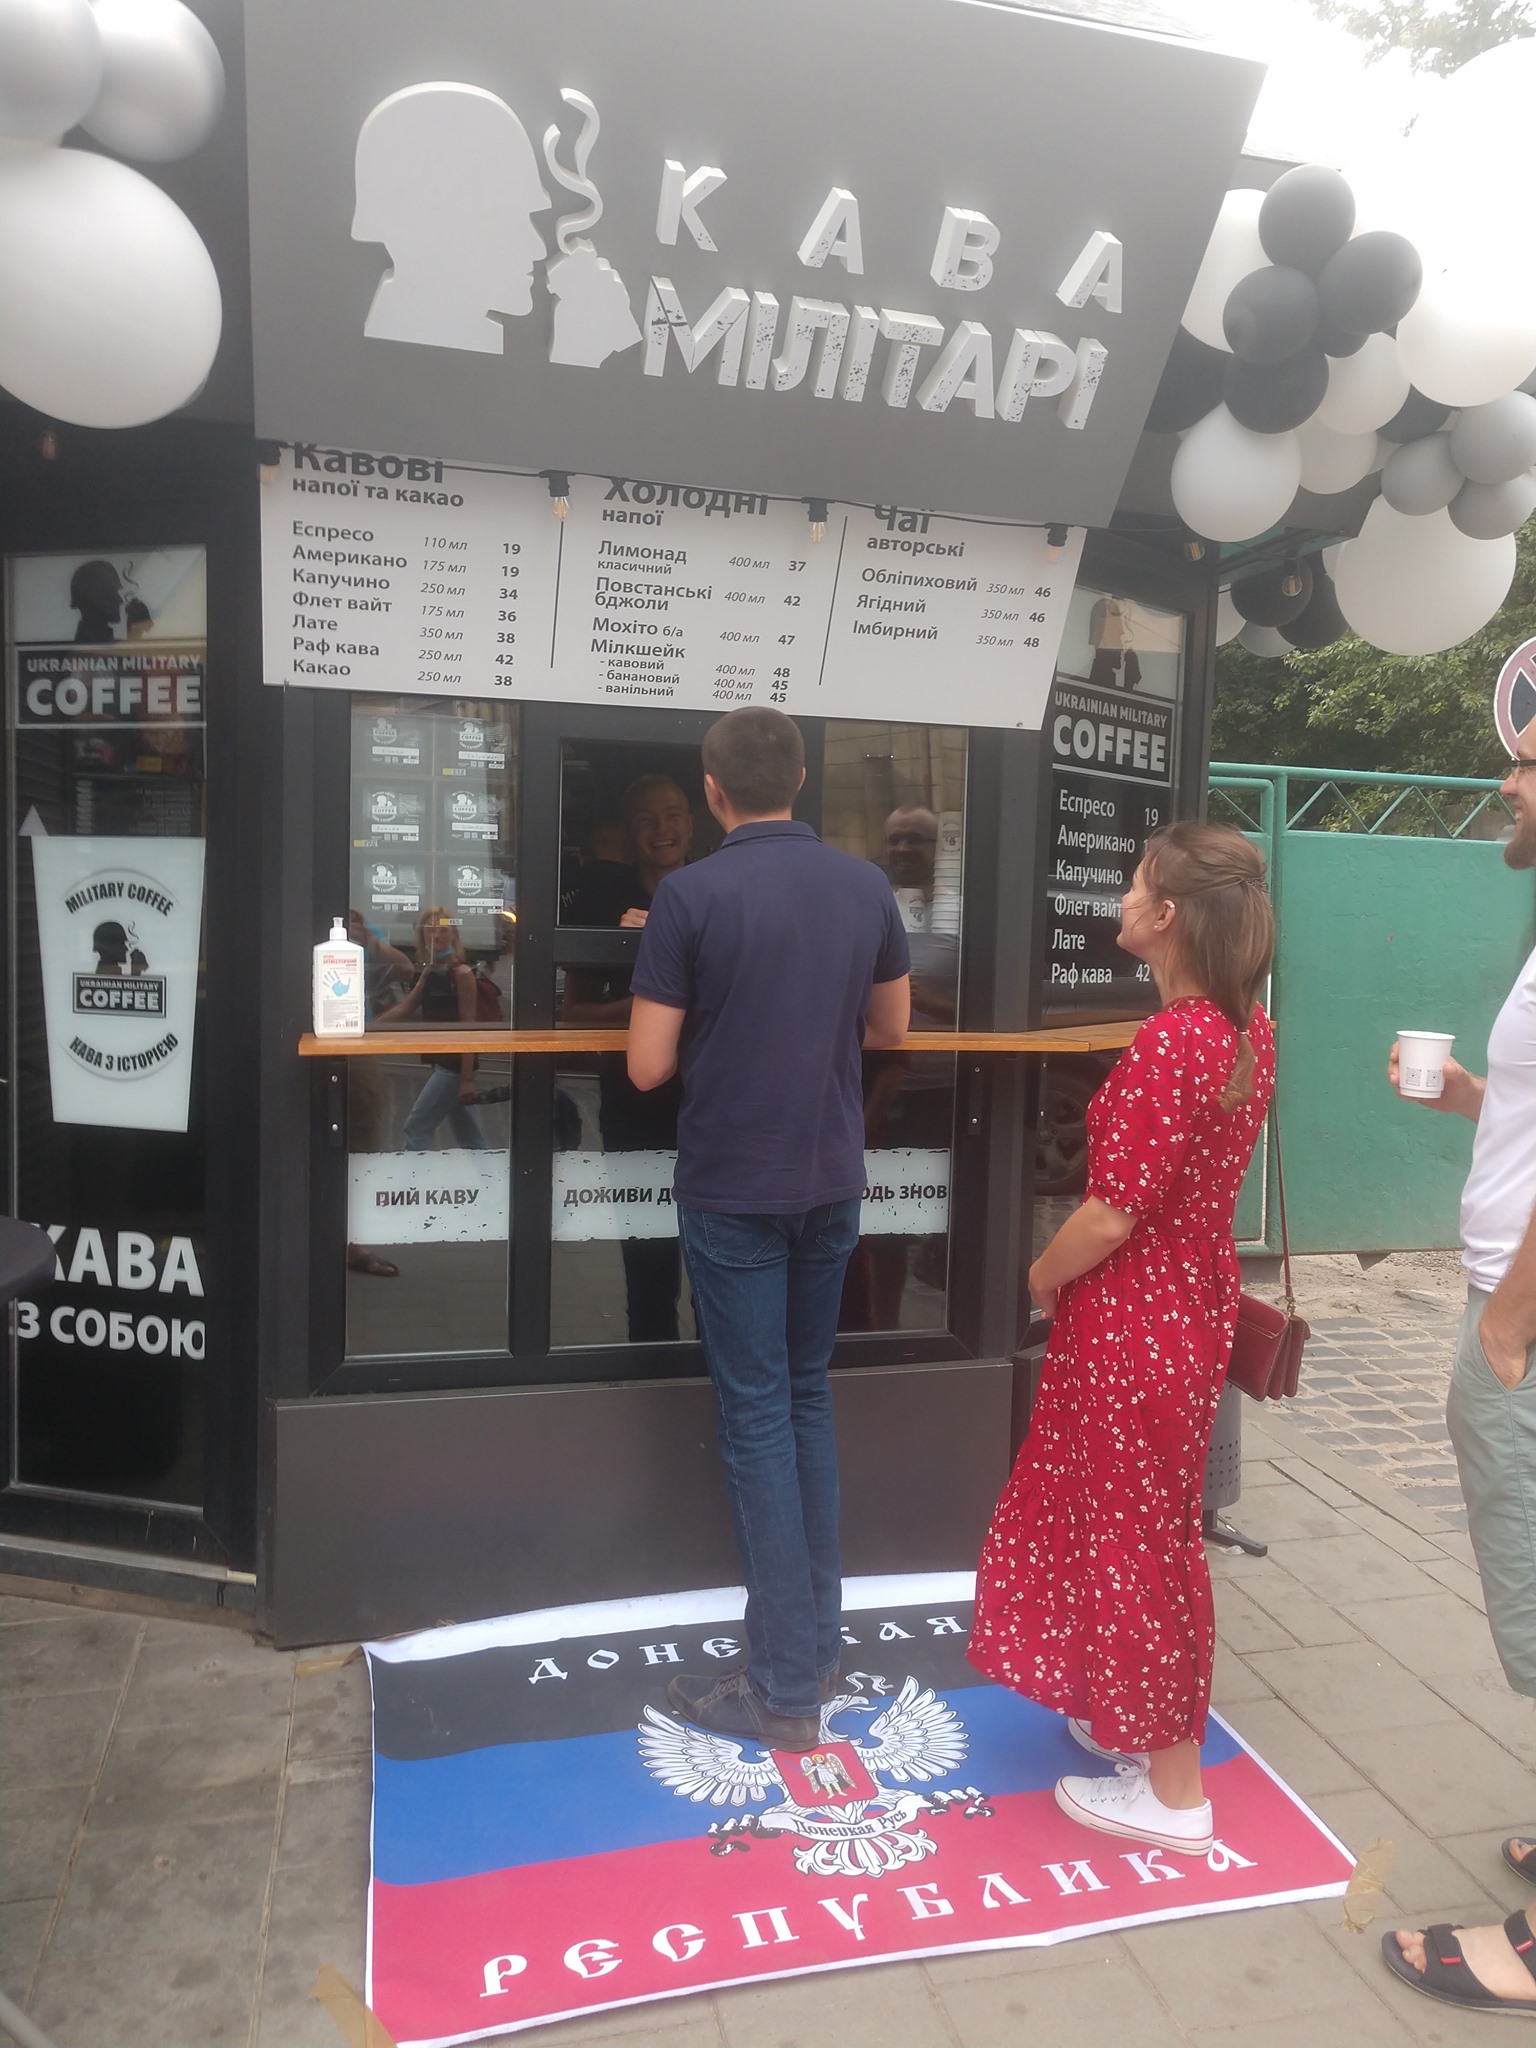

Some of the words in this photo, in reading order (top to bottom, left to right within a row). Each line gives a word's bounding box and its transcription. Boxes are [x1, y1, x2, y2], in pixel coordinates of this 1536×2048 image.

[656, 159, 1123, 313] КАВА
[643, 275, 1109, 430] МІЛІТАРІ
[294, 443, 443, 483] Кавові
[292, 478, 360, 497] напої
[364, 485, 389, 500] та
[396, 489, 464, 507] какао
[604, 478, 769, 518] Холодні
[602, 505, 663, 527] напої
[874, 504, 933, 533] Чаї
[292, 521, 374, 543] Еспресо
[423, 536, 446, 550] 110
[449, 542, 468, 551] мл
[503, 542, 521, 555] 19
[867, 537, 965, 558] авторські
[292, 545, 407, 568] Американо
[422, 560, 445, 572] 175
[447, 564, 467, 574] мл
[501, 565, 520, 578] 19
[598, 540, 687, 565] Лимонад
[729, 556, 752, 569] 400
[753, 559, 770, 570] мл
[789, 560, 806, 573] 37
[598, 560, 672, 576] класичний
[292, 569, 390, 591] Капучино
[420, 582, 444, 595] 250
[446, 586, 465, 596] мл
[499, 588, 518, 600] 34
[596, 576, 712, 600] Повстанські
[724, 591, 748, 604] 400
[749, 595, 765, 605] мл
[784, 595, 801, 607] 42
[862, 567, 978, 591] Обліпиховий
[986, 582, 1008, 594] 350
[1009, 585, 1024, 596] мл
[1035, 586, 1051, 598] 46
[292, 591, 343, 609] Флет
[347, 595, 392, 612] вайт
[420, 605, 443, 617] 175
[445, 609, 465, 619] мл
[498, 610, 517, 622] 36
[594, 592, 669, 613] бджоли
[857, 594, 926, 615] Ягідний
[981, 608, 1004, 620] 350
[1004, 612, 1019, 622] мл
[1029, 611, 1045, 623] 46
[292, 614, 337, 631] Лате
[419, 627, 442, 640] 350
[444, 631, 464, 641] мл
[497, 632, 515, 644] 38
[592, 617, 658, 637] Мохіто
[663, 624, 683, 638] б/а
[719, 631, 743, 643] 400
[744, 634, 760, 644] мл
[778, 634, 795, 646] 47
[853, 620, 939, 643] Імбирний
[976, 635, 999, 647] 350
[998, 637, 1014, 647] мл
[1023, 637, 1040, 648] 48
[293, 637, 330, 655] Раф
[334, 643, 380, 656] кава
[418, 649, 441, 661] 250
[443, 653, 463, 662] мл
[495, 654, 514, 665] 42
[590, 638, 686, 659] Мілкшейк
[27, 656, 118, 673] UKRAINIAN
[122, 654, 200, 671] MILITARY
[293, 658, 351, 676] Какао
[417, 671, 440, 683] 250
[442, 674, 461, 684] мл
[494, 675, 513, 687] 38
[607, 656, 664, 671] кавовий
[715, 664, 739, 676] 400
[739, 667, 755, 677] мл
[773, 667, 790, 678] 48
[605, 683, 674, 697] ванільний
[712, 689, 735, 701] 400
[736, 691, 752, 702] мл
[770, 691, 787, 703] 45
[606, 670, 680, 685] банановий
[713, 678, 737, 689] 400
[737, 681, 753, 690] мл
[772, 679, 788, 691] 45
[26, 675, 201, 716] COFFEE
[1055, 691, 1118, 718] UKRAINIAN
[1120, 705, 1167, 729] MILITARY
[1053, 714, 1166, 772] COFFEE
[1059, 789, 1115, 819] Еспресо
[1145, 807, 1158, 827] 19
[1058, 824, 1135, 854] Американо
[1056, 859, 1123, 887] Капучино
[65, 882, 124, 914] MILITARY
[128, 884, 174, 916] COFFEE
[1054, 893, 1089, 919] Флет
[1093, 897, 1122, 918] вайт
[1052, 929, 1085, 950] Лате
[80, 979, 122, 989] UKRAINIAN
[124, 981, 159, 991] MILITARY
[1052, 962, 1079, 988] Раф
[1082, 967, 1112, 984] кава
[1136, 964, 1150, 982] 42
[80, 989, 159, 1011] COFFEE
[69, 1036, 102, 1067] КАВА
[117, 1032, 178, 1072] ІСТОРІЄЮ
[376, 1187, 420, 1206] ПИЙ
[425, 1188, 479, 1206] КАВУ
[564, 1187, 653, 1208] ДОЖИВИ
[657, 1187, 673, 1206] Д
[900, 1184, 948, 1200] ЗНОВ
[17, 1301, 40, 1339] З
[50, 1305, 205, 1360] СОБОЮ
[528, 1616, 967, 1684] ДОНЕАЯ
[795, 1820, 877, 1838] Донецкая
[879, 1811, 907, 1830] Русь
[479, 1839, 1257, 1999] РЕСПУБЛИКА
